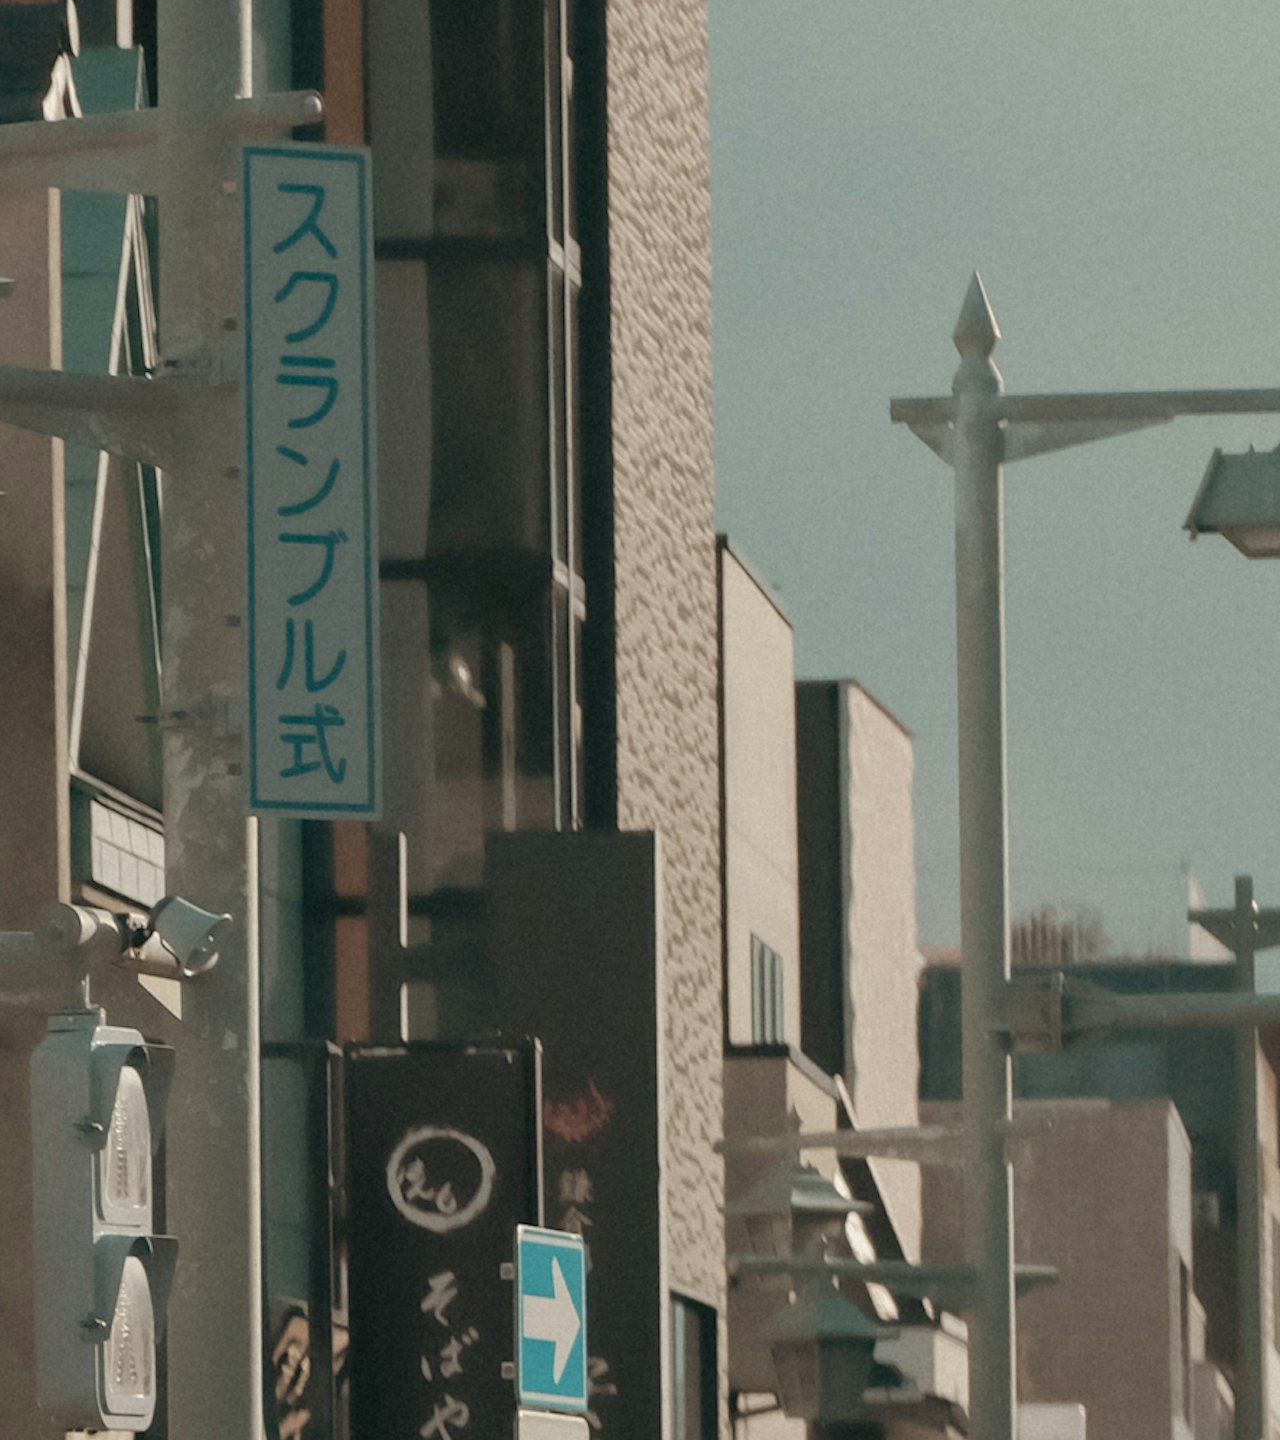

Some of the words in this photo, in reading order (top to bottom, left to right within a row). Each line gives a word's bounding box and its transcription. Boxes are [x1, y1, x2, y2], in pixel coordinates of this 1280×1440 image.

[273, 181, 350, 787] スクランブル式
